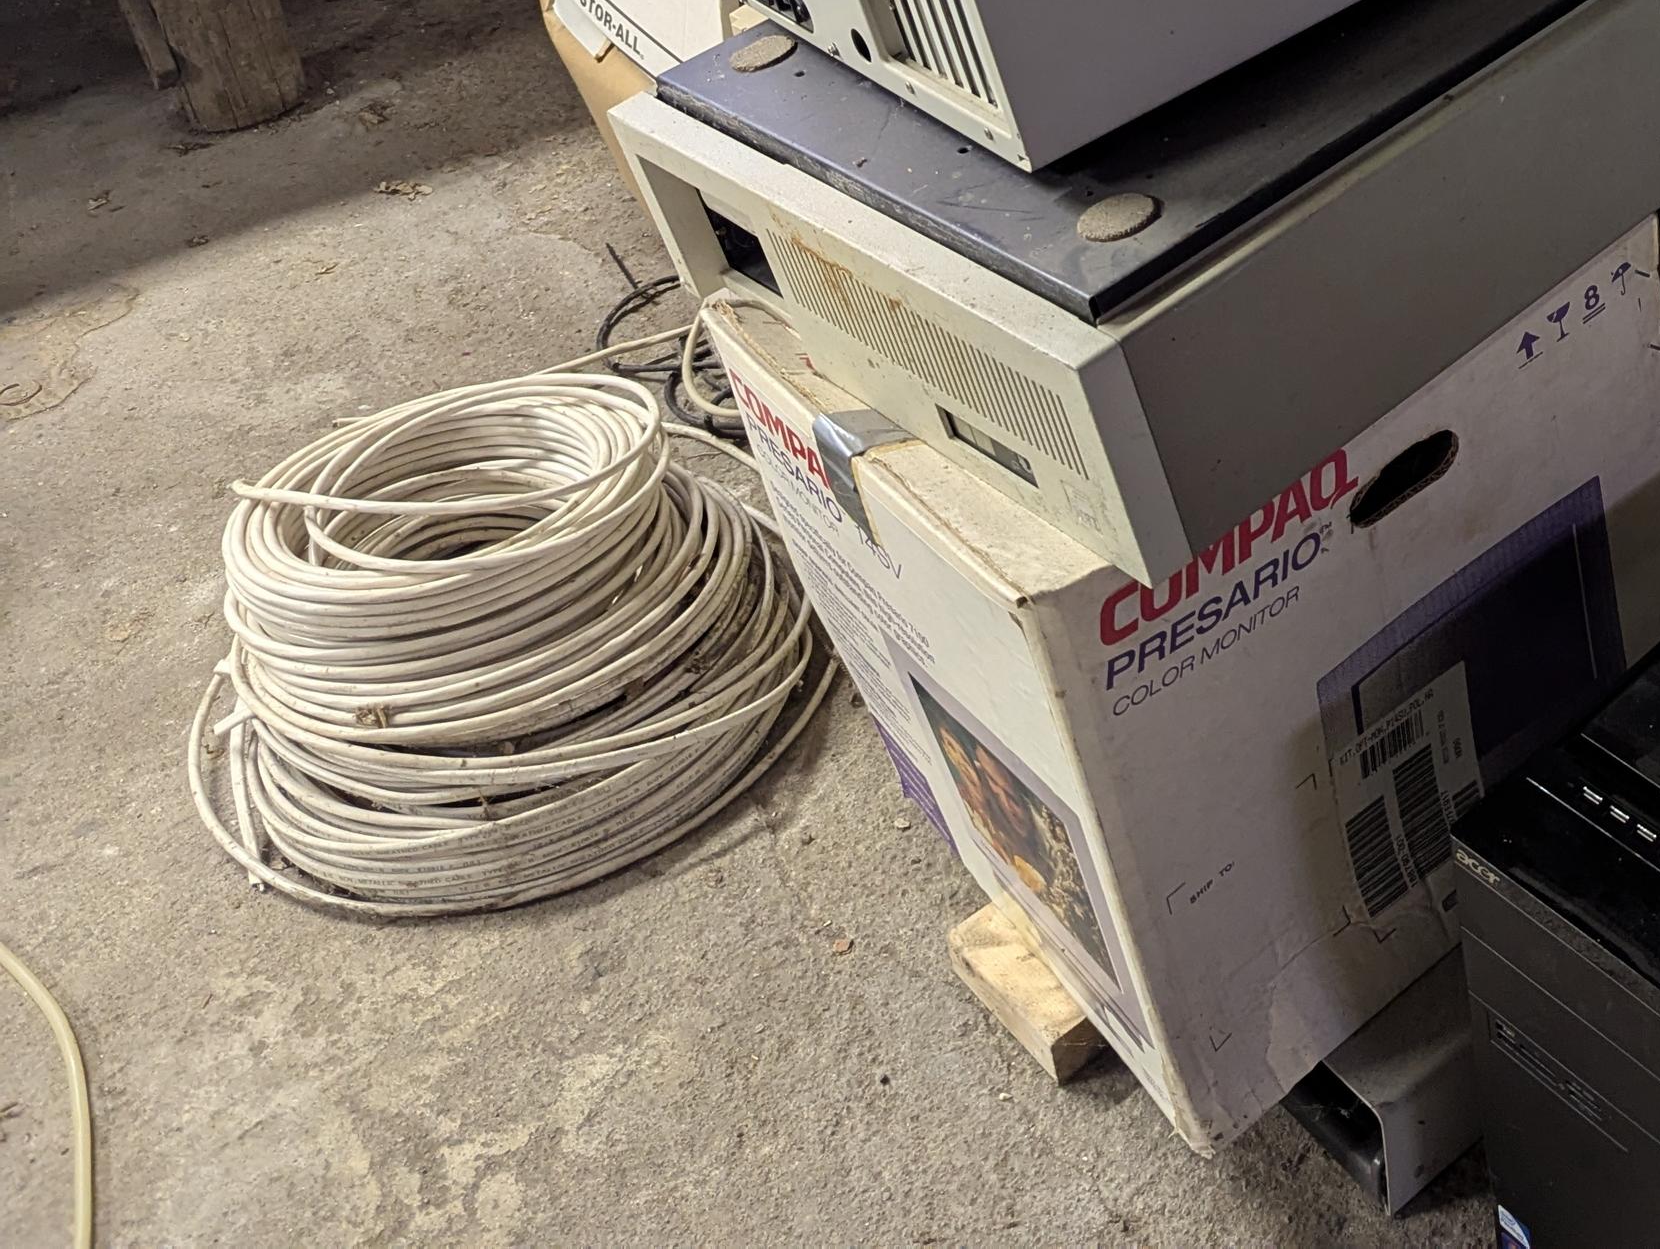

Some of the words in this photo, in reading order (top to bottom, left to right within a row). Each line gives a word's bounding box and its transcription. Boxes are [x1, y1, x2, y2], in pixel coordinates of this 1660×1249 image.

[729, 368, 831, 491] COMPA
[1113, 655, 1195, 717] COLOR
[1200, 586, 1300, 665] MONITOR
[1189, 879, 1213, 905] SHIP
[1455, 848, 1500, 886] acer
